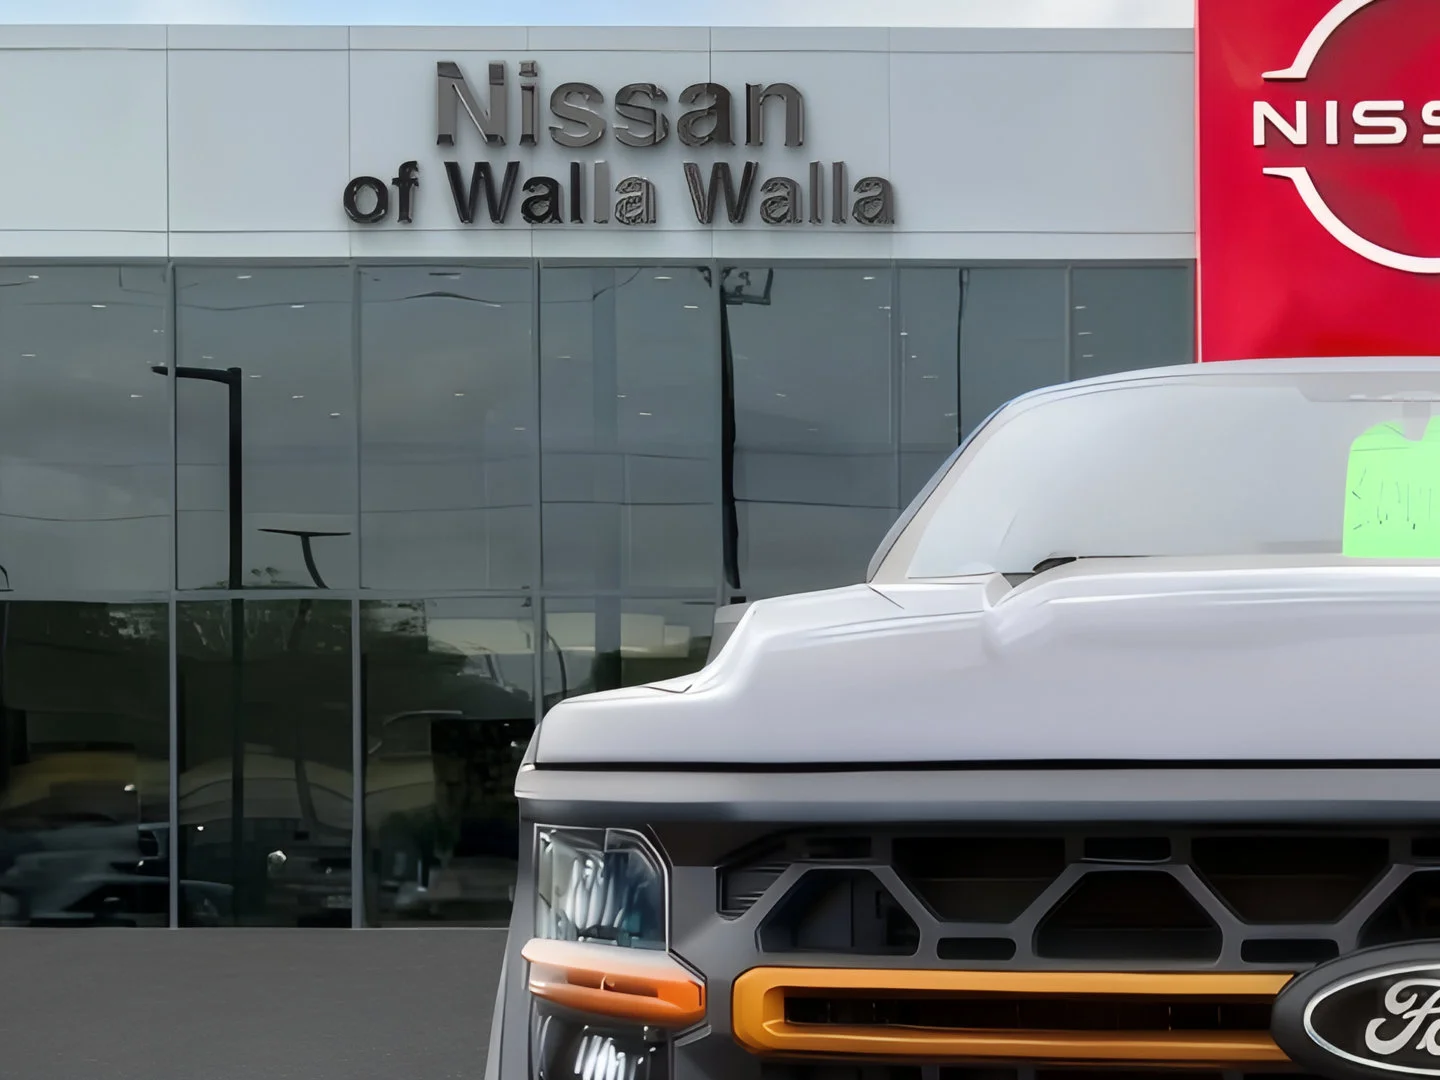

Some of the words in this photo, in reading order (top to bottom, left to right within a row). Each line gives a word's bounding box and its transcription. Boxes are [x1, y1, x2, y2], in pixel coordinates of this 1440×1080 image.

[435, 60, 806, 148] Nissan
[343, 160, 421, 224] of
[444, 160, 658, 226] Walla
[683, 160, 896, 226] Walla
